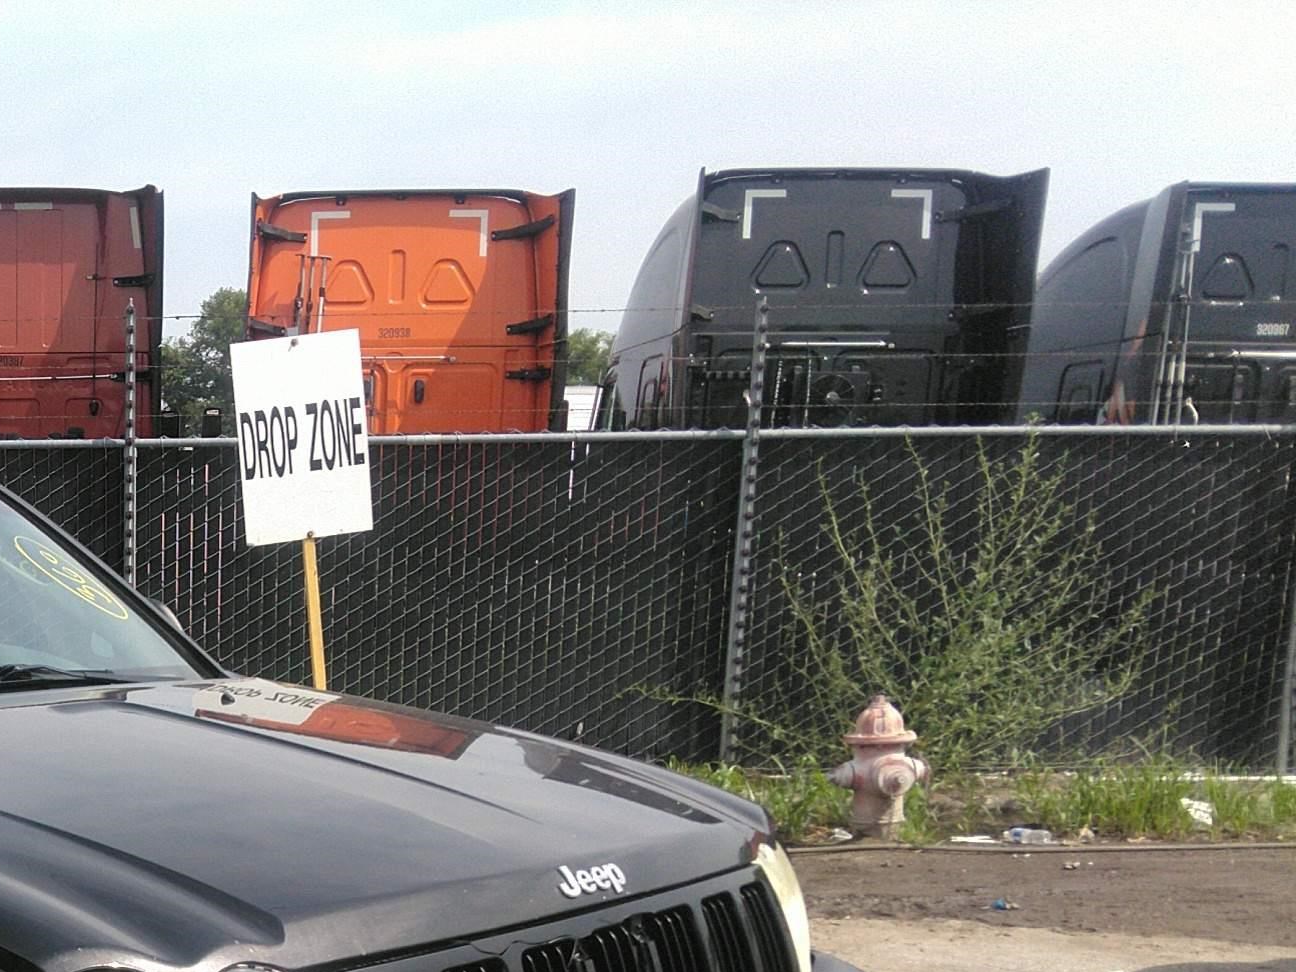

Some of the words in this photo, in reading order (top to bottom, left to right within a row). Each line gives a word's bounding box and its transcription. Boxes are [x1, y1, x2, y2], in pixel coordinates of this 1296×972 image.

[240, 406, 298, 480] DROP
[305, 397, 365, 471] ZONE
[558, 863, 627, 898] Jeep
